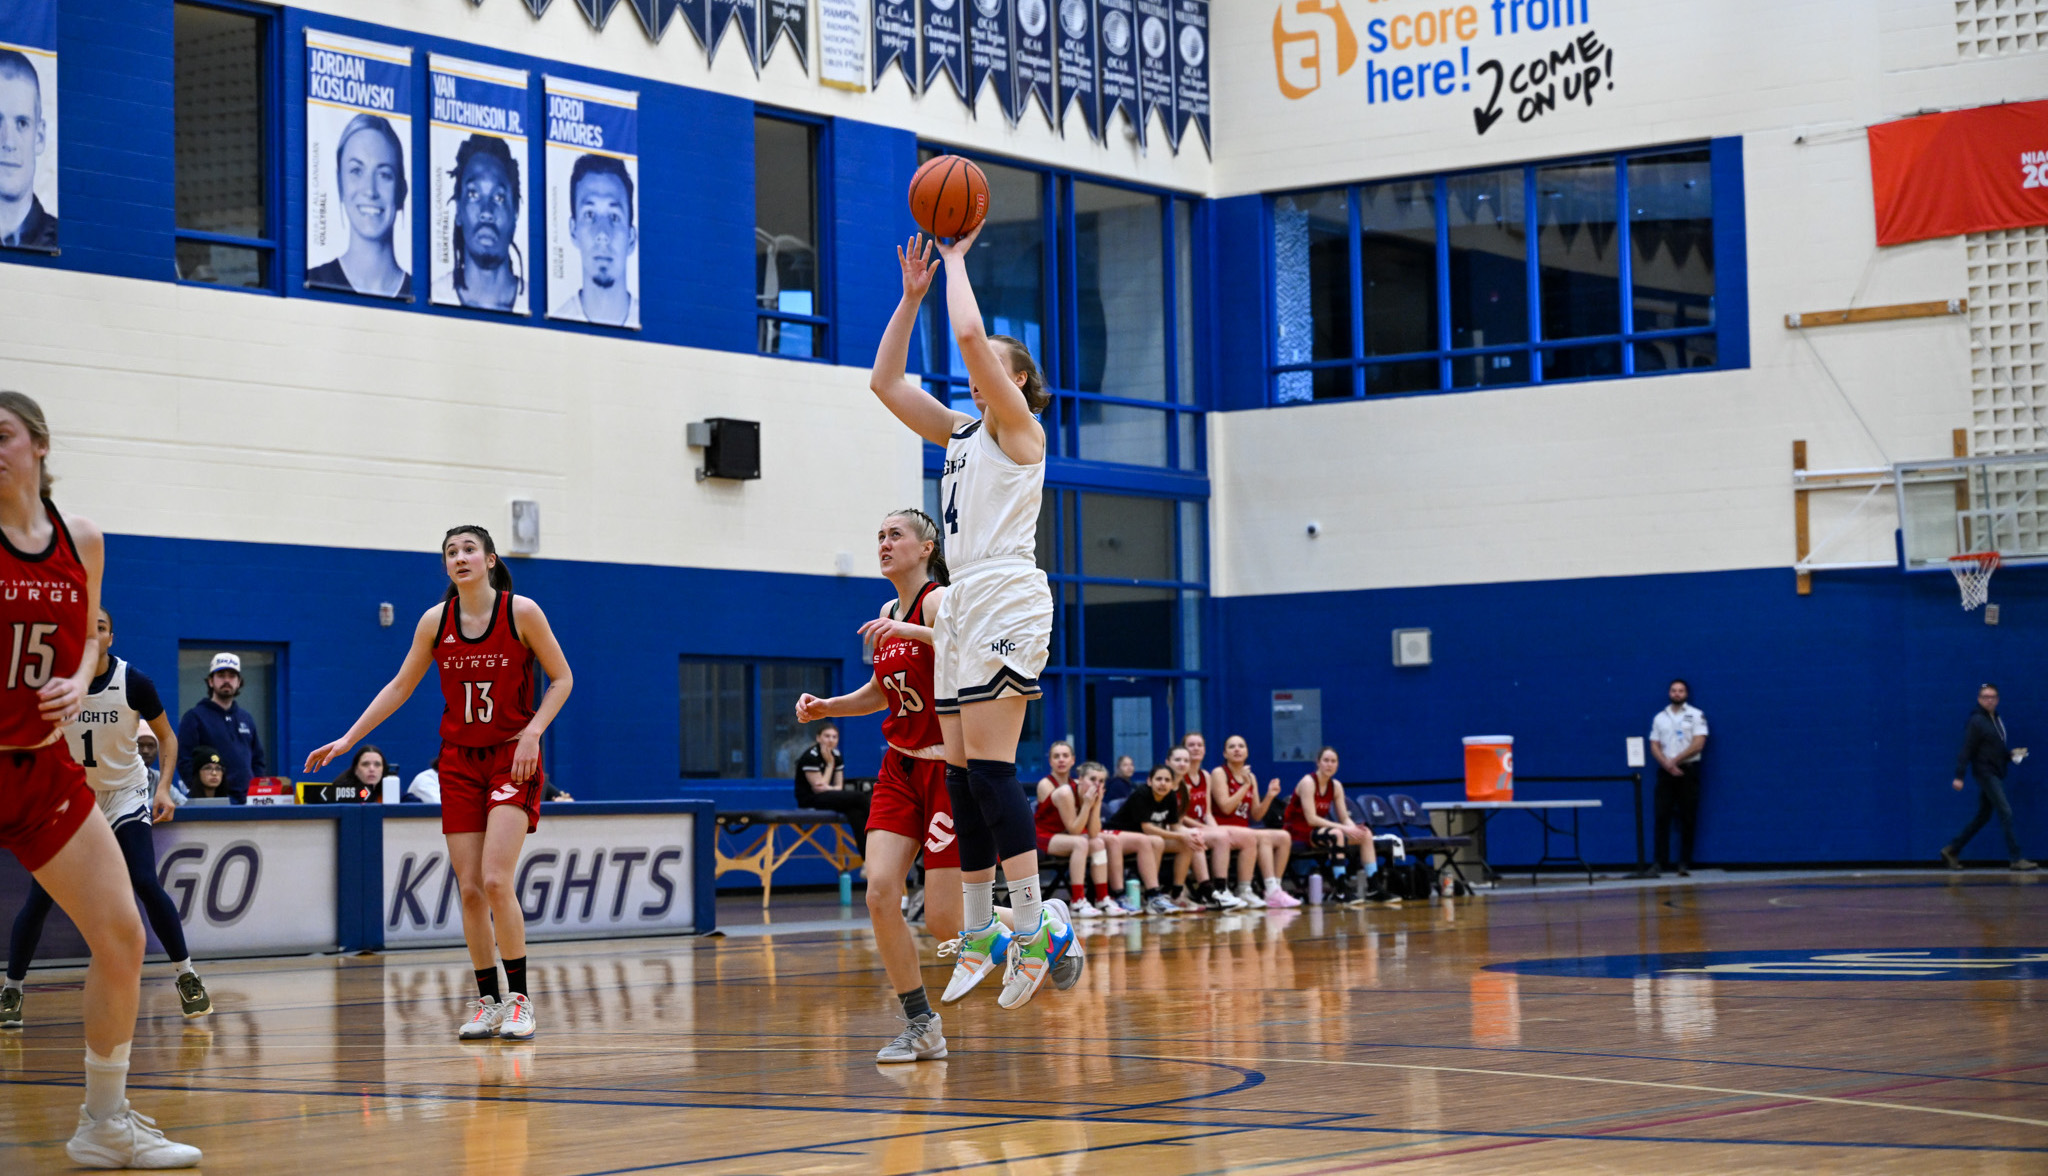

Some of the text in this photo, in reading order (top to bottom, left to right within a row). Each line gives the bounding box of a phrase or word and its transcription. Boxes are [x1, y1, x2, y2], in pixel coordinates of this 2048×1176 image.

[1367, 4, 1478, 54] score
[1491, 0, 1589, 36] from
[310, 49, 365, 82] JORDAN
[1366, 46, 1471, 105] here!
[1509, 30, 1605, 94] COME
[311, 74, 394, 110] KOSLOWSKI
[433, 73, 456, 99] VAN
[1517, 48, 1614, 123] ON UP!
[434, 96, 524, 134] HUTCHINSON JR.
[549, 96, 584, 122] JORDI
[549, 118, 603, 148] AMORES
[12, 580, 71, 589] LAWRENCE
[7, 623, 58, 690] 15
[443, 658, 509, 669] SURGE
[991, 638, 1016, 657] NKC
[463, 681, 494, 724] 13
[882, 670, 925, 718] 23
[81, 729, 97, 767] 1
[335, 787, 356, 801] poss
[157, 842, 262, 925] GO
[387, 848, 683, 929] KNGHTS
